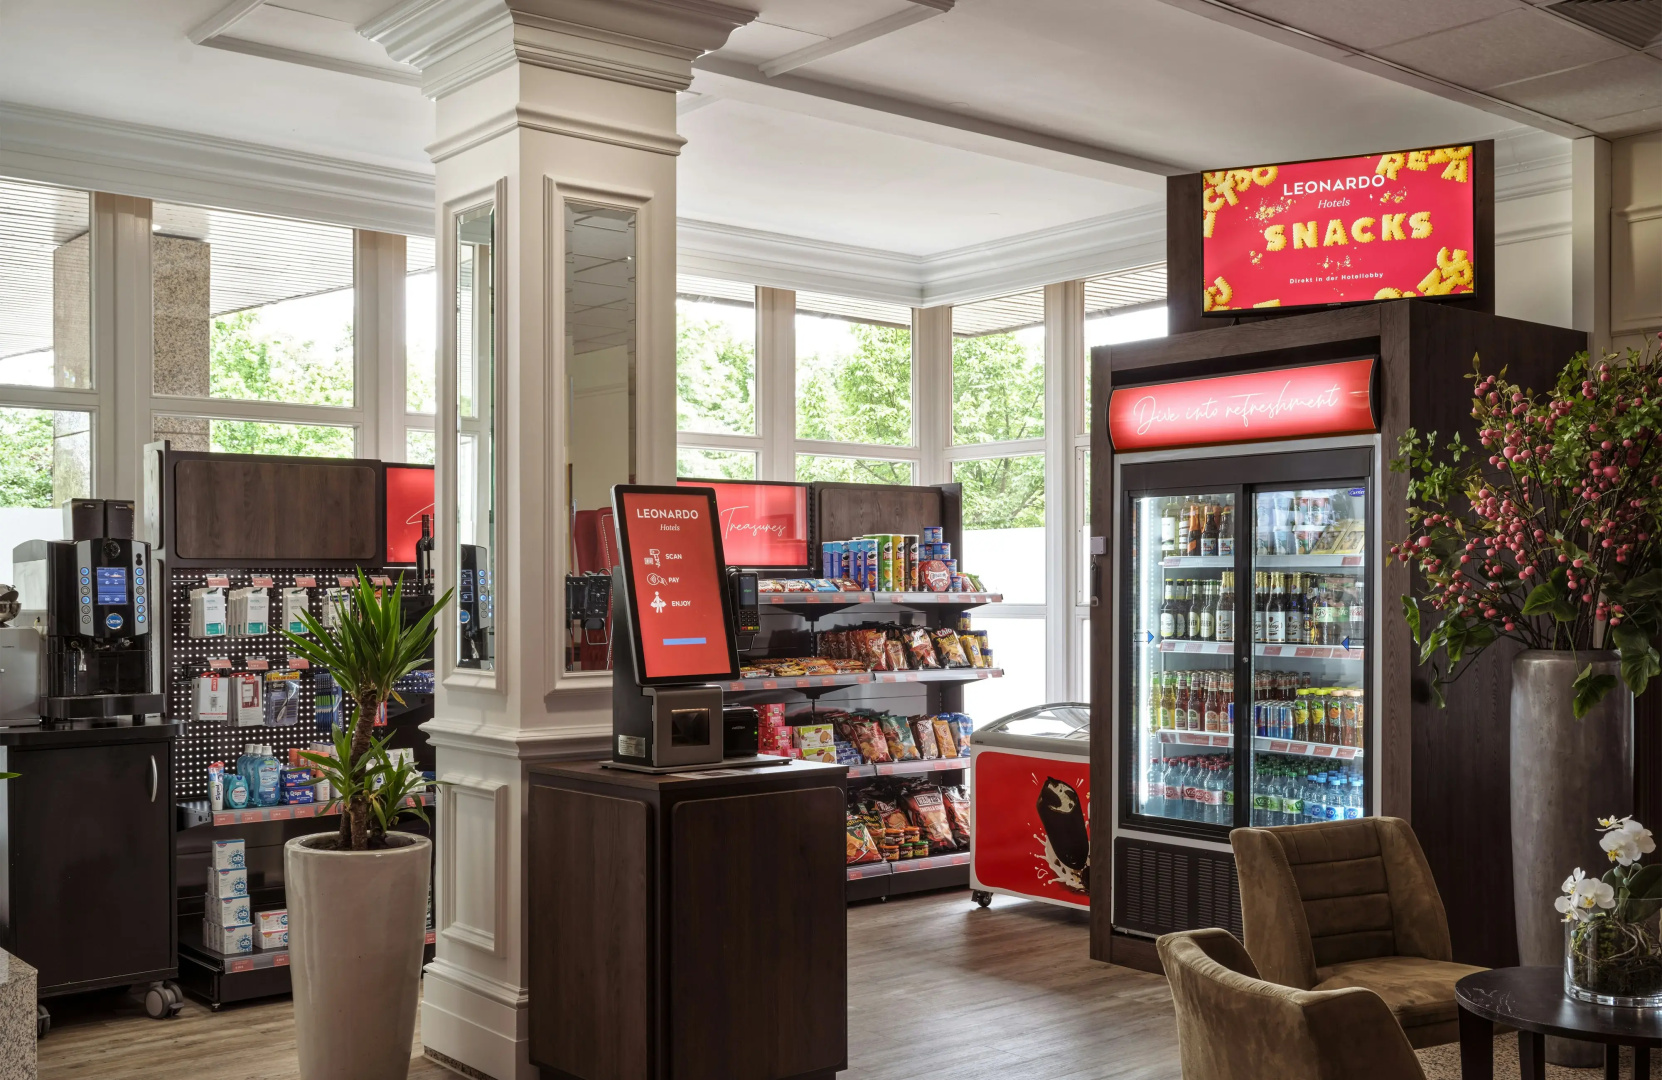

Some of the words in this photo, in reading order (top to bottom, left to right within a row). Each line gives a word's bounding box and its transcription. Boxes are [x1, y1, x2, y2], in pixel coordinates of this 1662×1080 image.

[1283, 174, 1385, 196] LEONARDO
[1317, 198, 1351, 209] Hotels
[1264, 211, 1433, 251] SNACKS
[1341, 272, 1384, 280] Hotellobby
[1133, 395, 1179, 435] Dive
[1185, 397, 1218, 420] into
[1225, 380, 1340, 427] refreshment
[637, 508, 699, 520] LEONARDO
[660, 523, 681, 532] Hotels
[720, 505, 786, 540] Treasures
[668, 576, 680, 584] PAY
[671, 600, 691, 608] ENJOY
